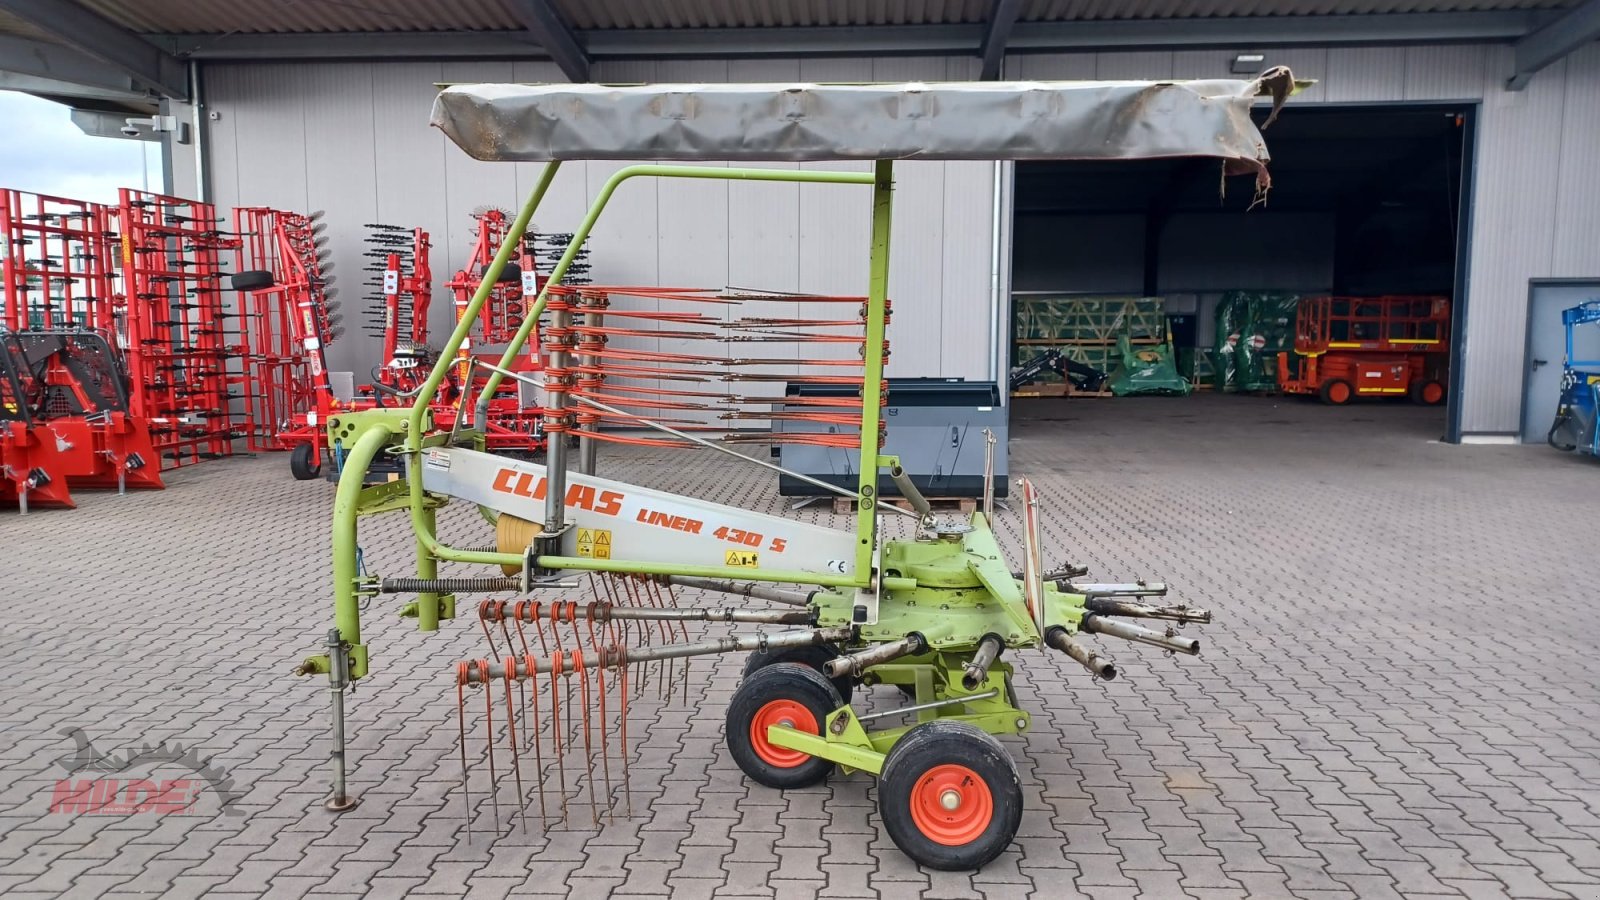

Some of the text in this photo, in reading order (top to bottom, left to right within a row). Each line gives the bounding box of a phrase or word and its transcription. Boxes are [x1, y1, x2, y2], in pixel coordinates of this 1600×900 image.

[636, 508, 703, 534] LINER
[713, 526, 763, 547] 430
[769, 538, 787, 553] S
